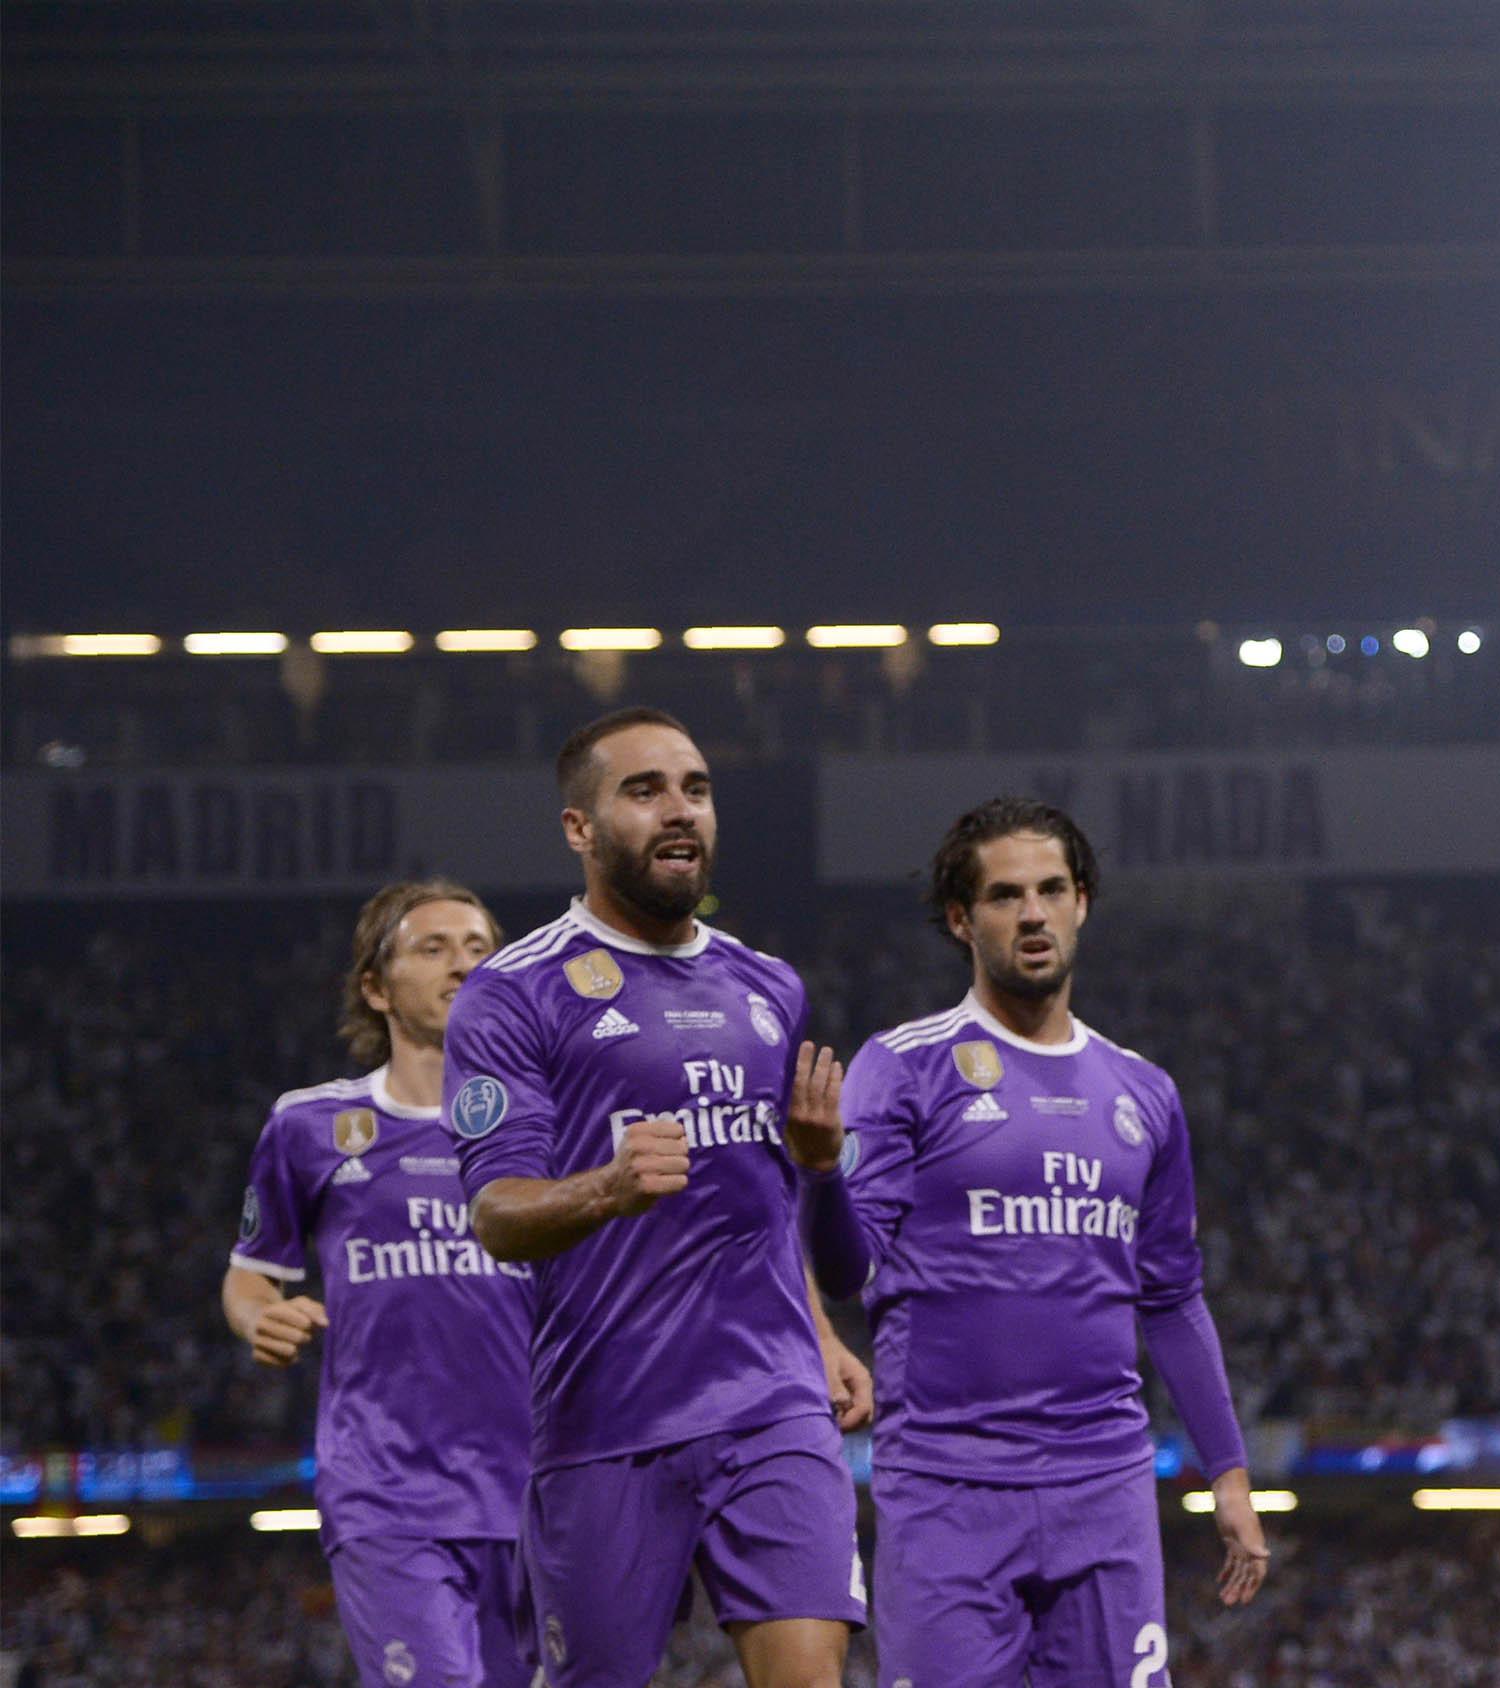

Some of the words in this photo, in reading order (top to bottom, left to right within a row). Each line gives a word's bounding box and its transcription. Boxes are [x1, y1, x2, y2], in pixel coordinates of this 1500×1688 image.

[1112, 764, 1325, 866] NADA
[683, 1059, 744, 1100] Fly
[1043, 1151, 1103, 1192] Fly
[406, 1197, 468, 1236] Fly
